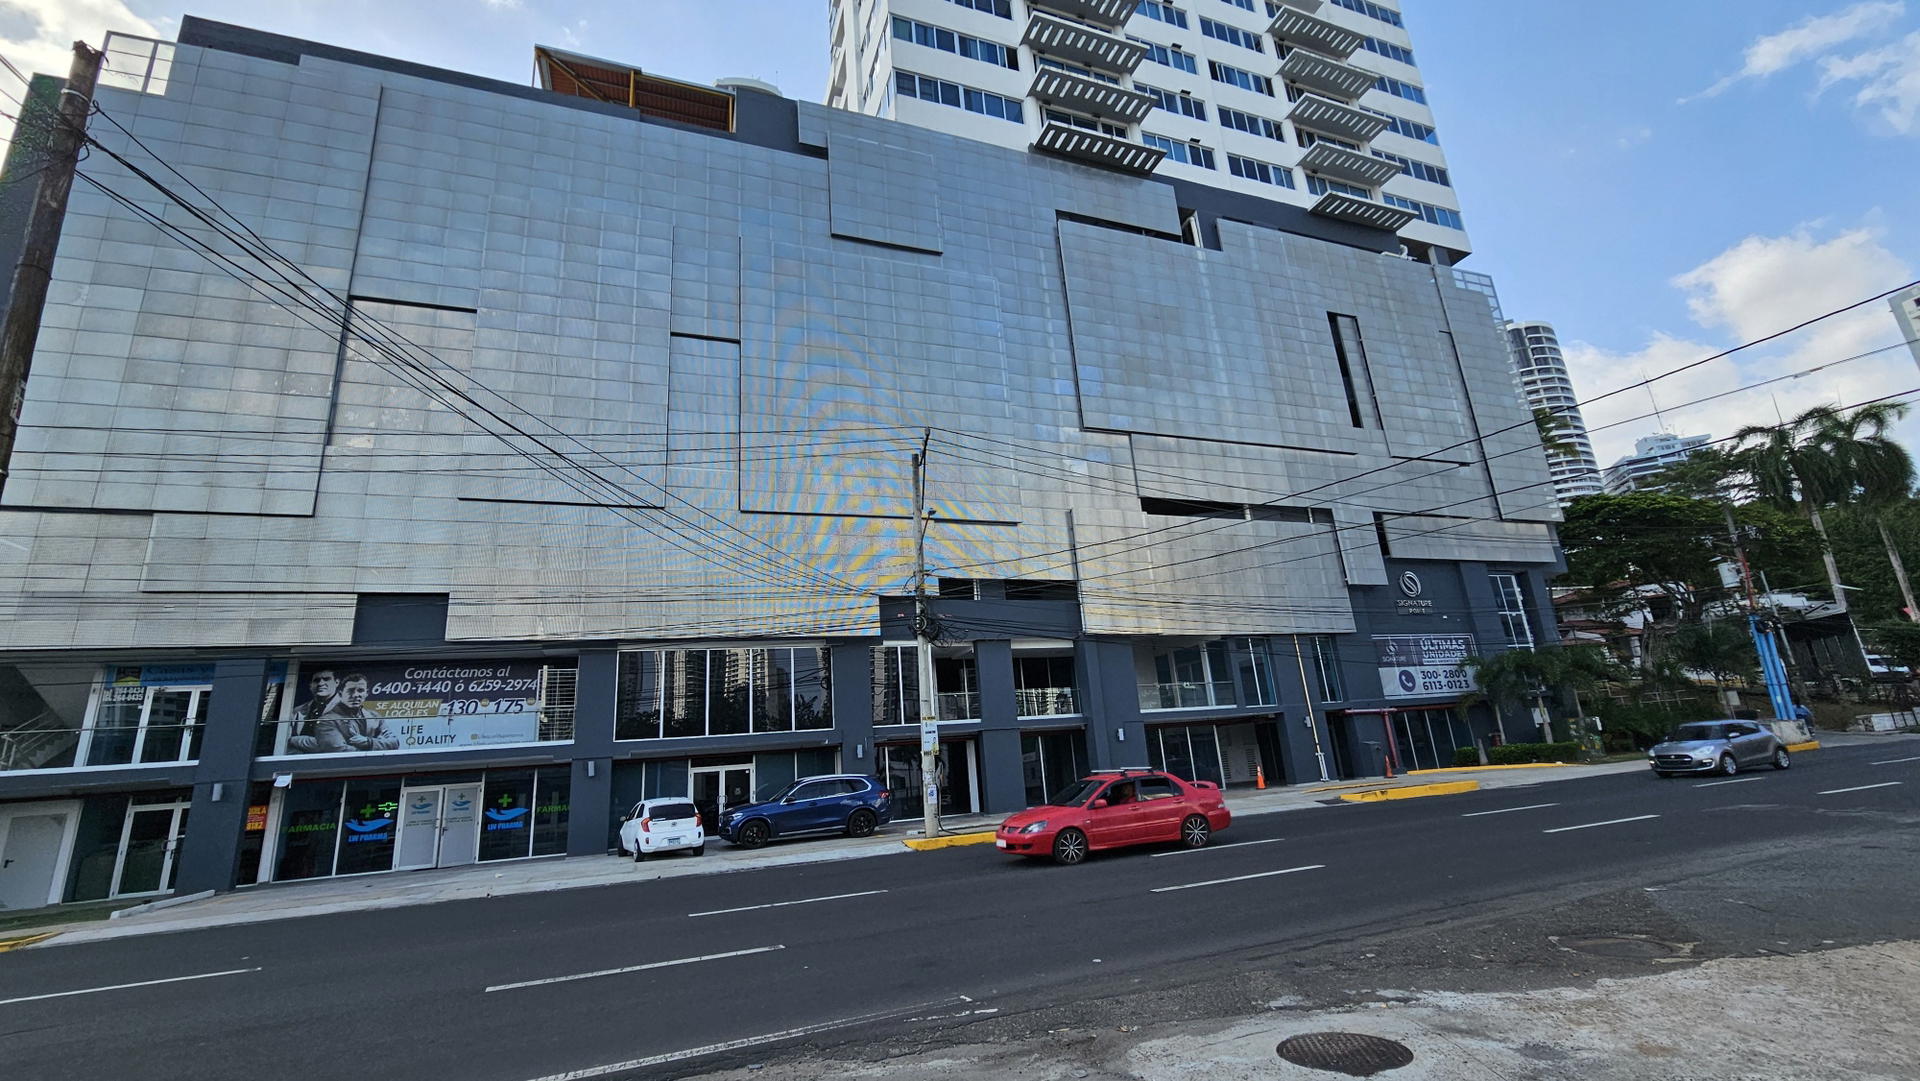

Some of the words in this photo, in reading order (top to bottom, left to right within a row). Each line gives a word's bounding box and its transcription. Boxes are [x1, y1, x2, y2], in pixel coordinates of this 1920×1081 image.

[1396, 599, 1433, 607] SIGNATURE
[1420, 638, 1465, 650] ÚLTIMAS
[1423, 650, 1467, 659] UNIDADES
[404, 666, 493, 679] Contáctanos
[497, 666, 511, 677] al
[371, 681, 452, 695] 6400-1440
[454, 680, 465, 693] ó
[468, 679, 538, 692] 6259-2974
[1422, 680, 1470, 690] 6113-0123
[375, 702, 389, 710] SE
[389, 700, 440, 711] ALQUILAN
[494, 699, 526, 714] 175
[385, 709, 429, 717] LOCALES
[401, 725, 423, 735] LIFE
[406, 734, 457, 745] QUALITY
[281, 823, 337, 833] FARMACIA
